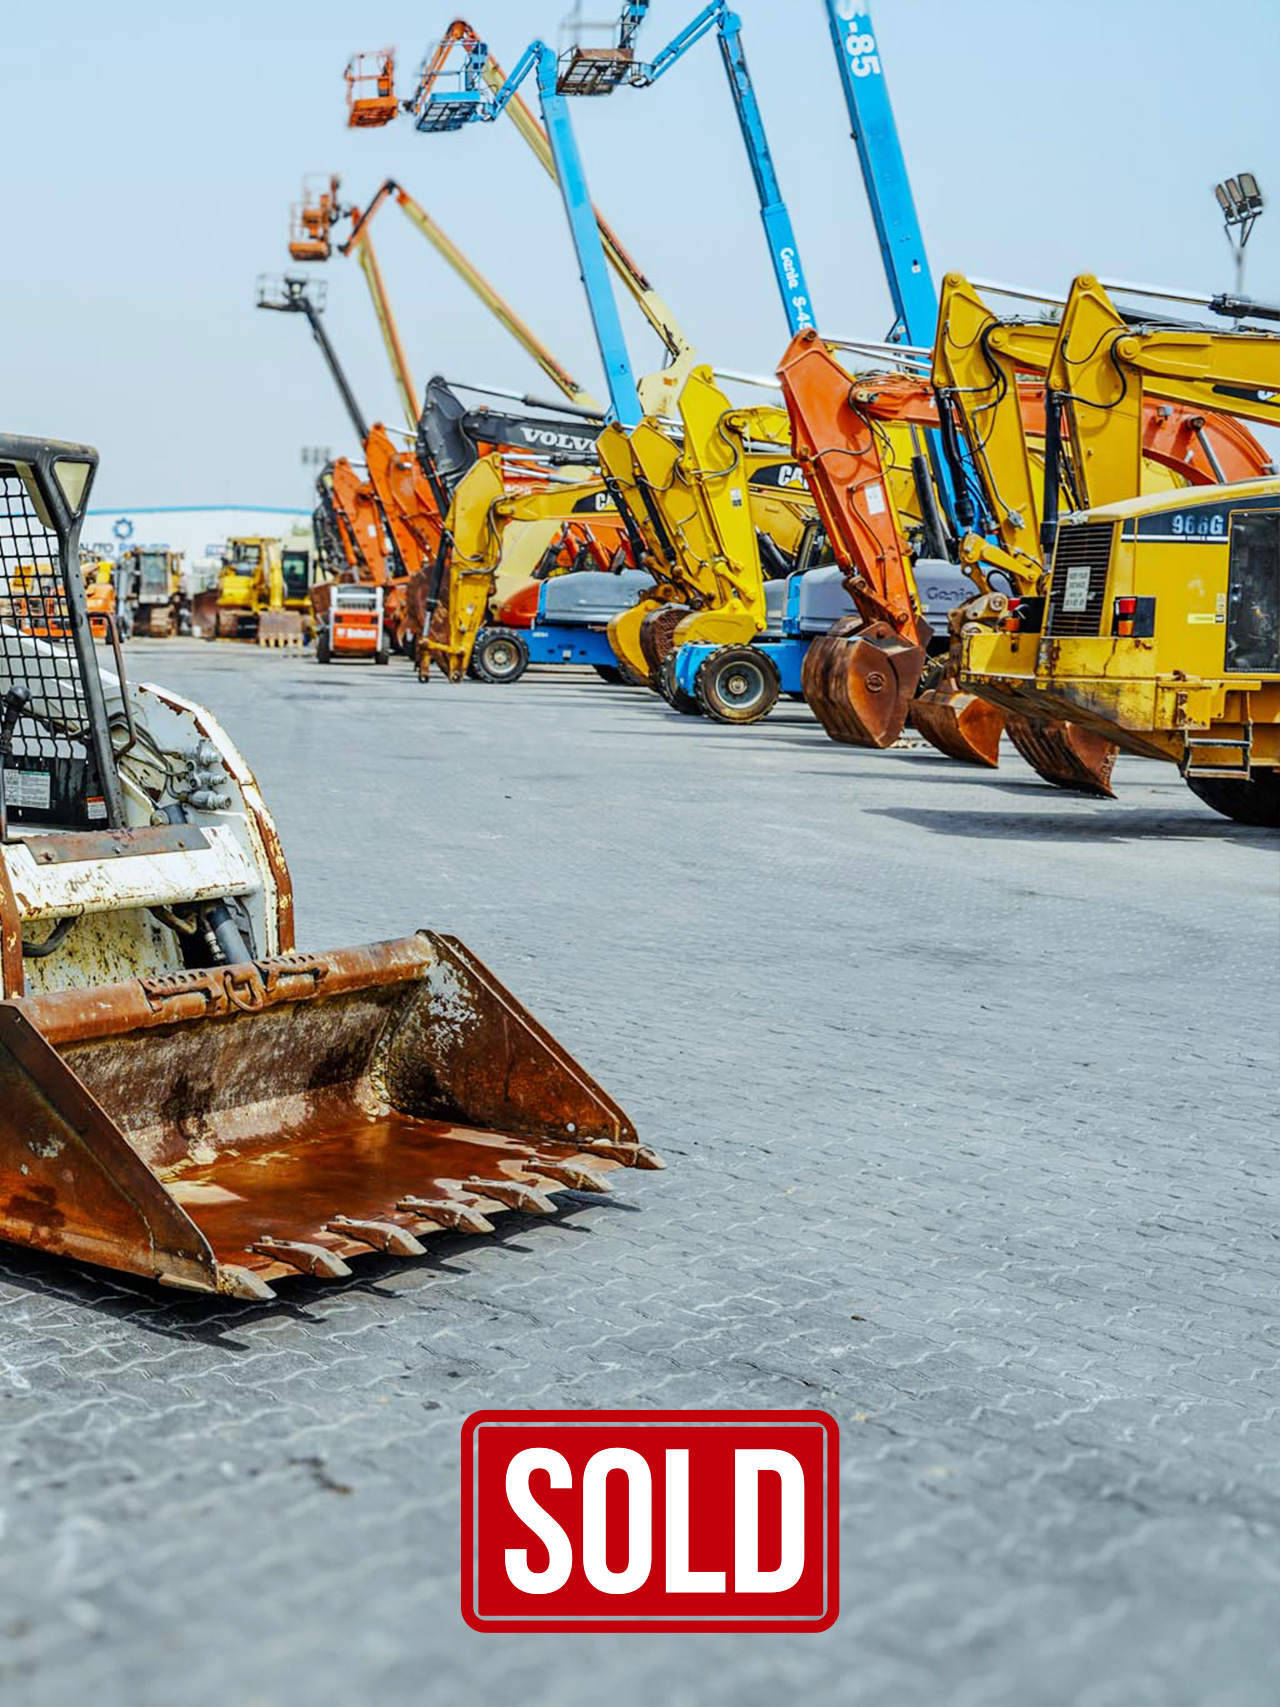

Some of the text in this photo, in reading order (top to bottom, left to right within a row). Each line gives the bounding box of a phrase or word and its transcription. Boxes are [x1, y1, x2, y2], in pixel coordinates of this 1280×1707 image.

[780, 247, 799, 290] Genie
[778, 465, 809, 490] CA
[1172, 515, 1224, 535] 966G
